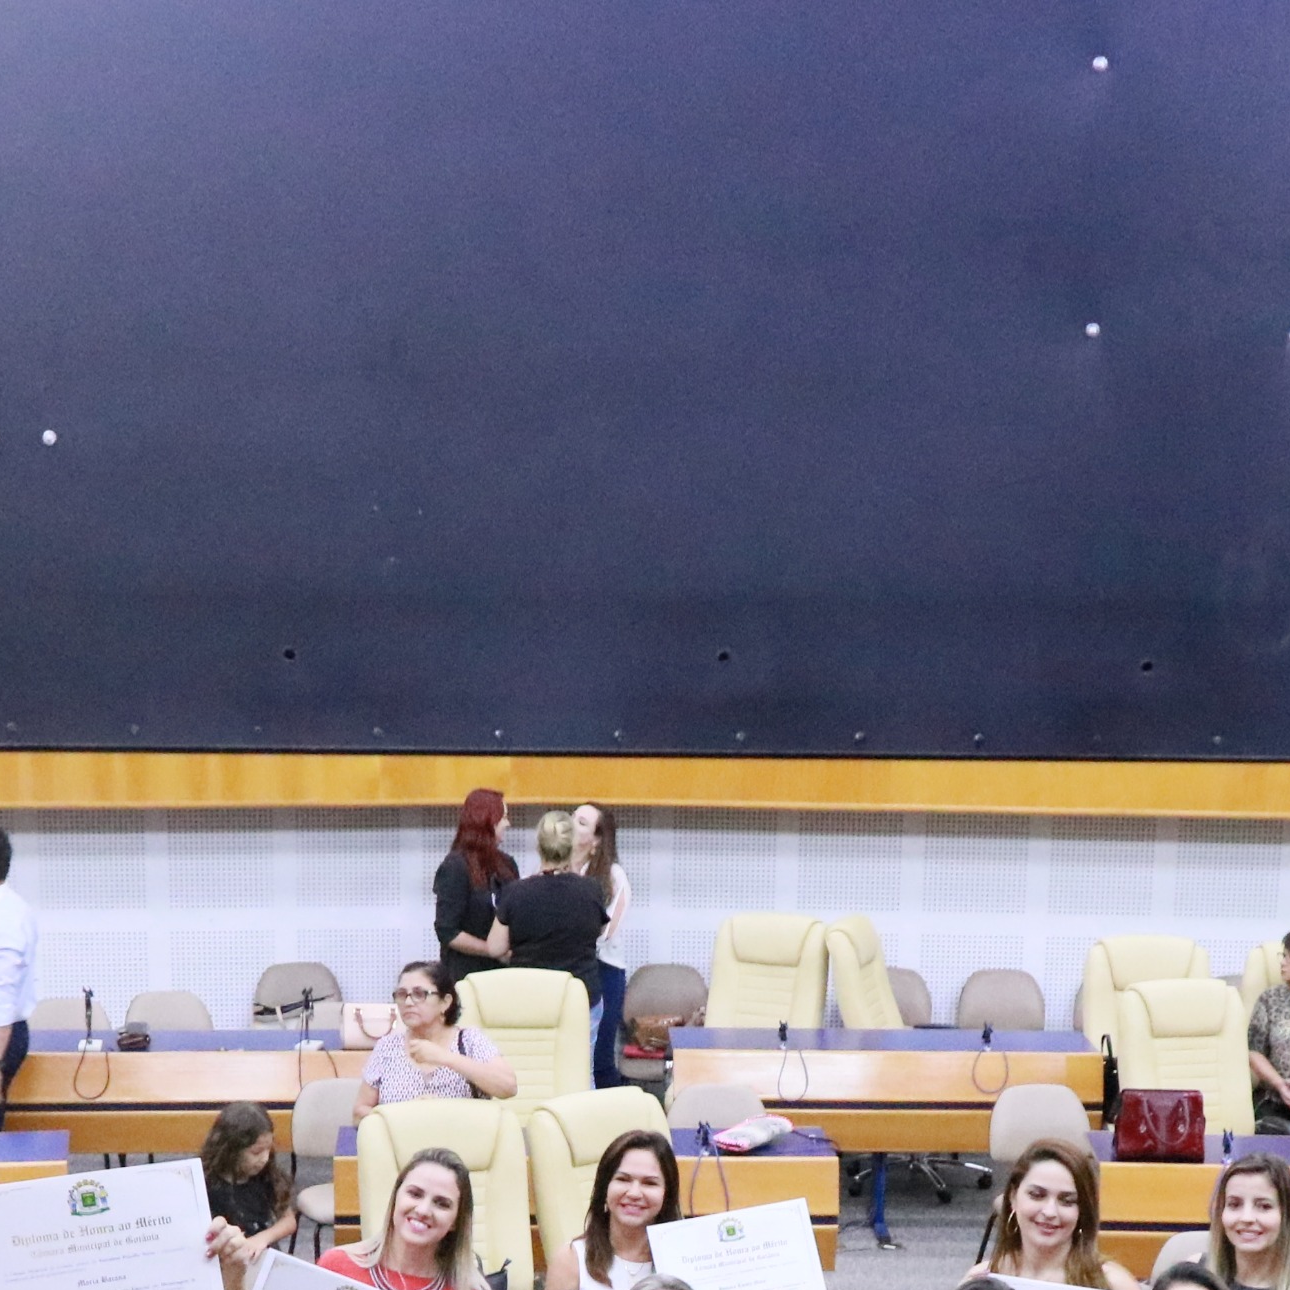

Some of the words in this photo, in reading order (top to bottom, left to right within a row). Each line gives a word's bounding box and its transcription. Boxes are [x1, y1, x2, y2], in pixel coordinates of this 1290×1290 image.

[11, 1233, 58, 1246] Diploma
[62, 1229, 74, 1239] de
[79, 1224, 114, 1236] Honra
[117, 1222, 131, 1231] ao
[135, 1216, 171, 1228] Mérito
